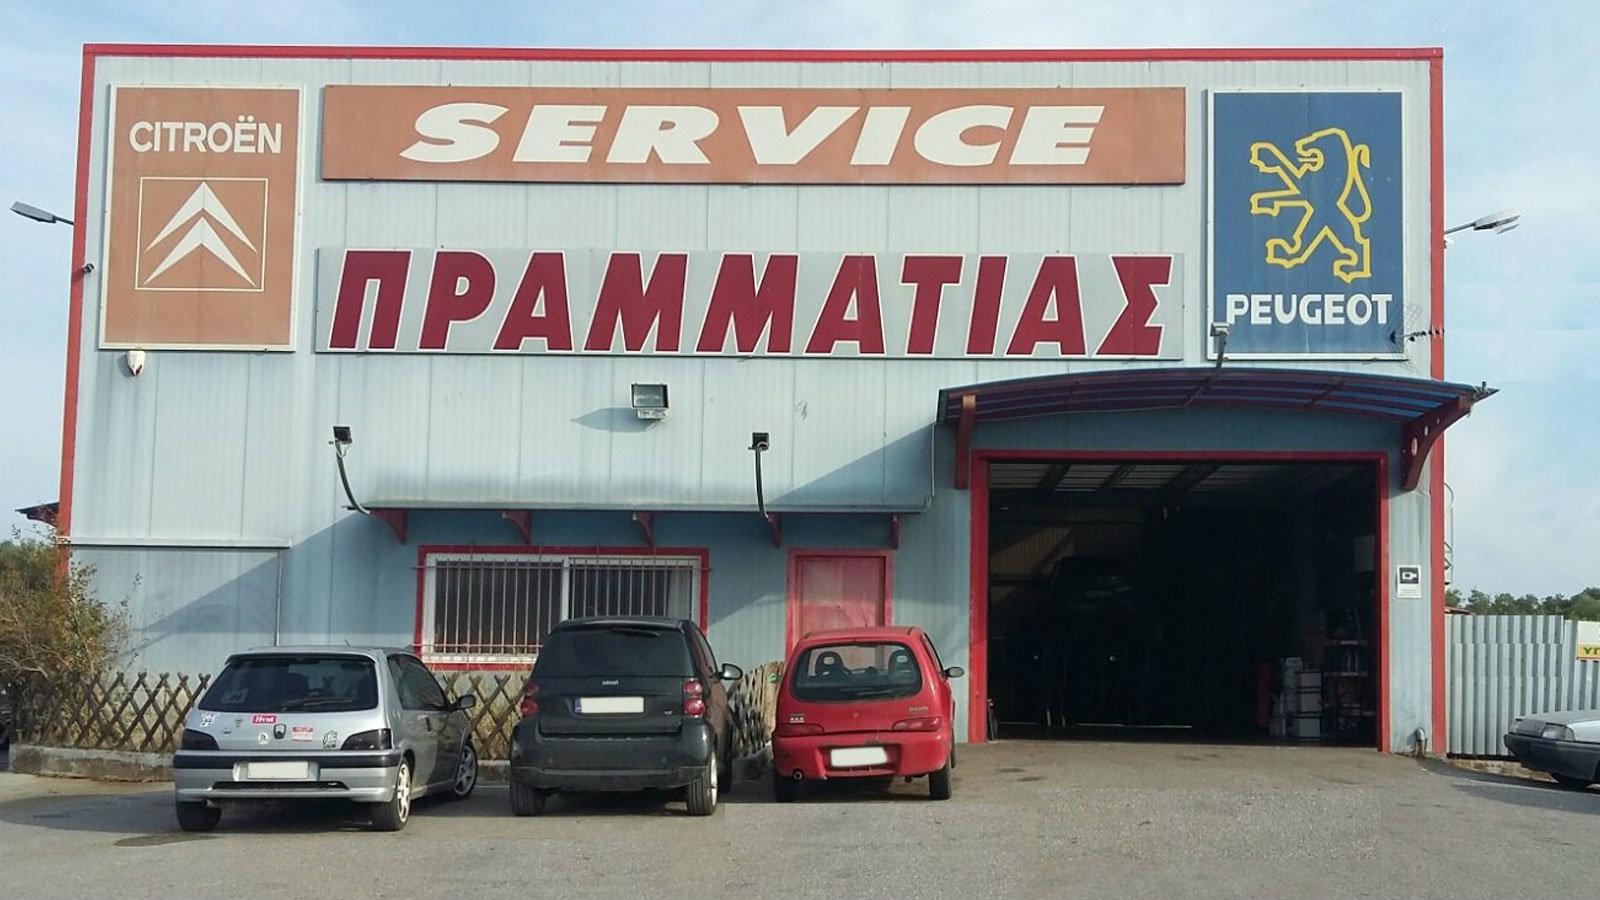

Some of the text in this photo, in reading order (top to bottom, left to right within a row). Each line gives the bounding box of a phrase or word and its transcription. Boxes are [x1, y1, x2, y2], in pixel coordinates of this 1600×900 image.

[129, 115, 282, 154] CITROËN
[399, 102, 1105, 166] SERVICE
[329, 250, 1172, 357] ΠΡΑΜΜΑΤΙΑΣ
[1226, 293, 1393, 325] PEUGEOT
